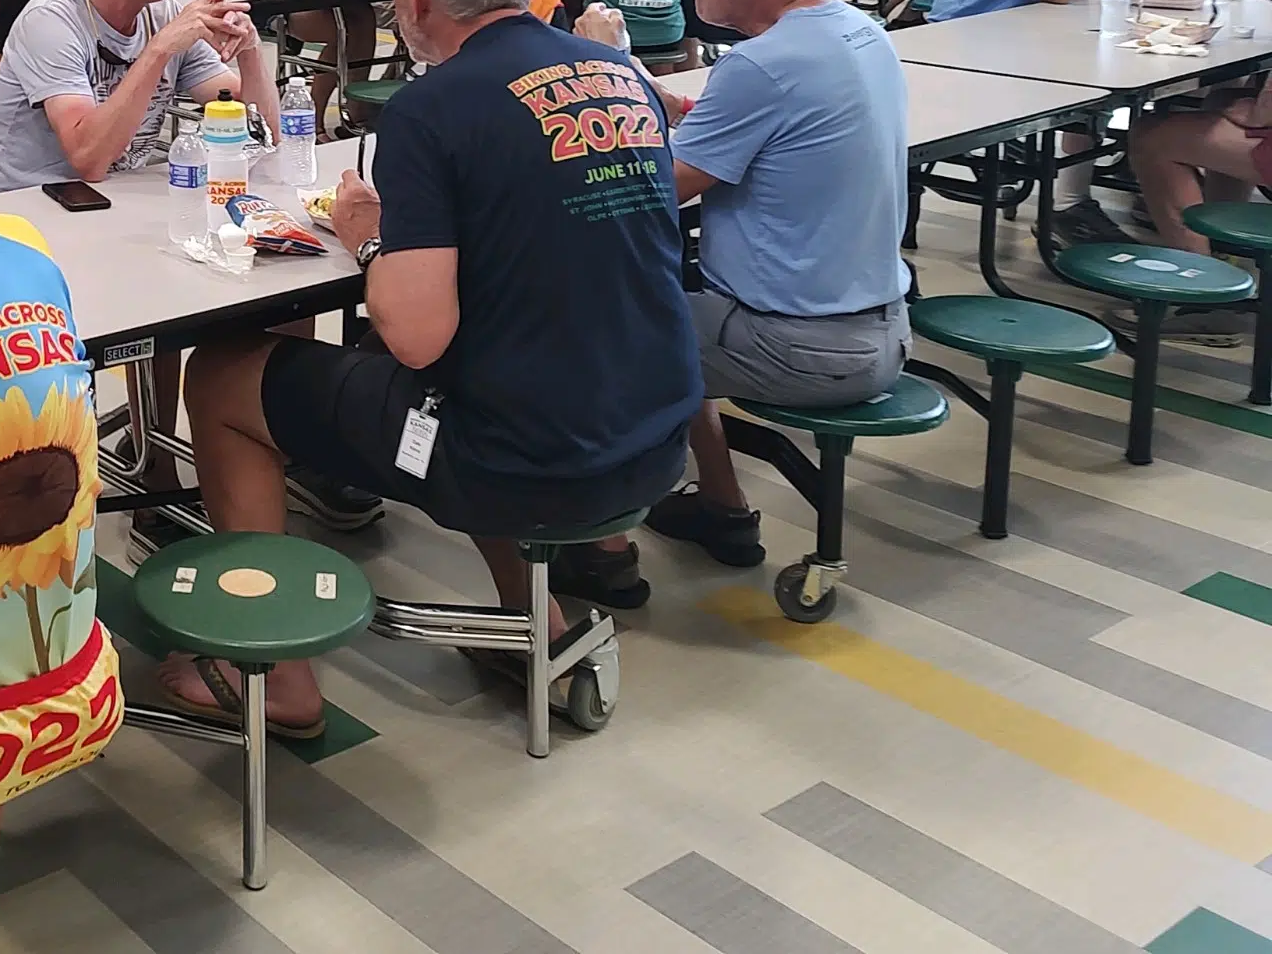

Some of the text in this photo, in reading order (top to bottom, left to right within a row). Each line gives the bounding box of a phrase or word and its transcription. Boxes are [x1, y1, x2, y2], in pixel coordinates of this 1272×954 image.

[507, 60, 639, 97] BIKING ACROSS
[521, 75, 650, 119] KANSAS
[541, 104, 665, 162] 2022
[585, 164, 626, 184] JUNE
[107, 344, 140, 361] SELECT
[410, 421, 432, 434] KANSAS
[6, 780, 31, 797] TO
